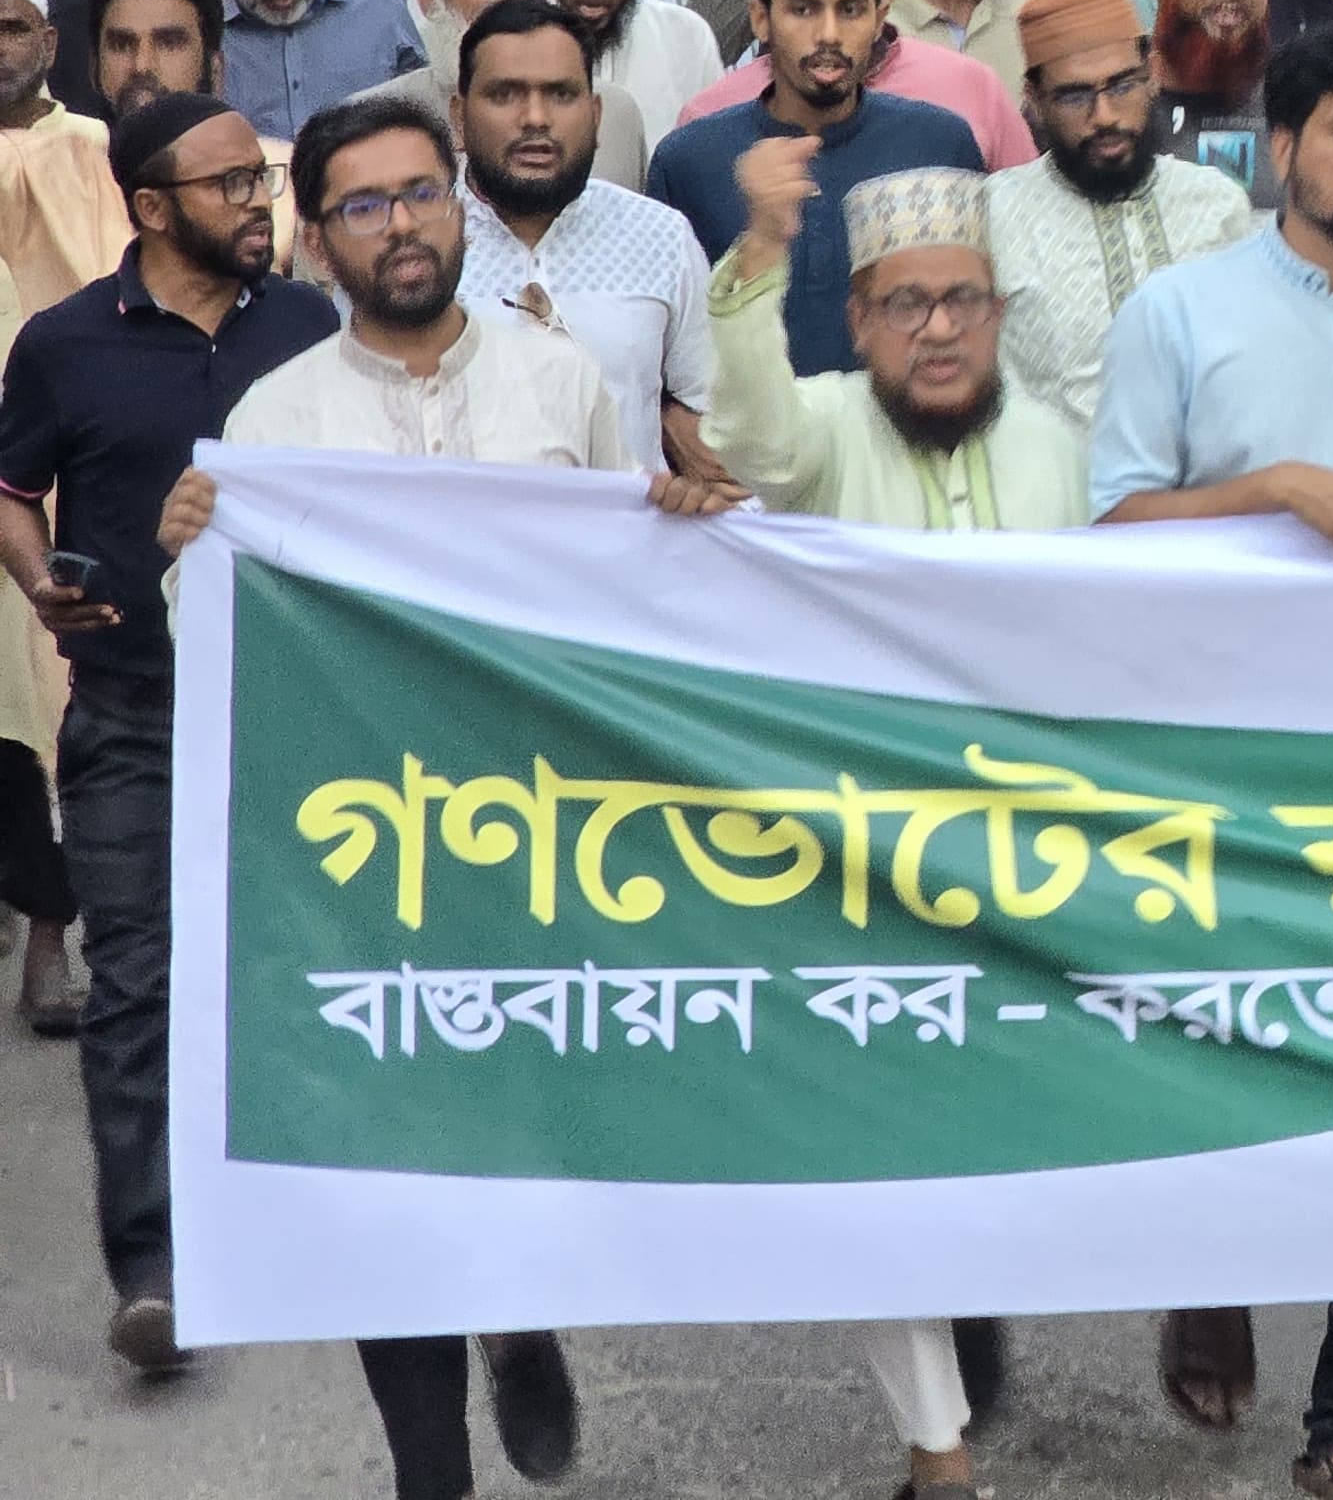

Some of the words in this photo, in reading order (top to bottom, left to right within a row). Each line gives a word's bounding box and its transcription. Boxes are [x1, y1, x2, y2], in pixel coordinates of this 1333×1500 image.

[296, 745, 1231, 930] গণভোটের
[306, 960, 770, 1060] বাস্তবায়ন
[797, 962, 983, 1048] কর
